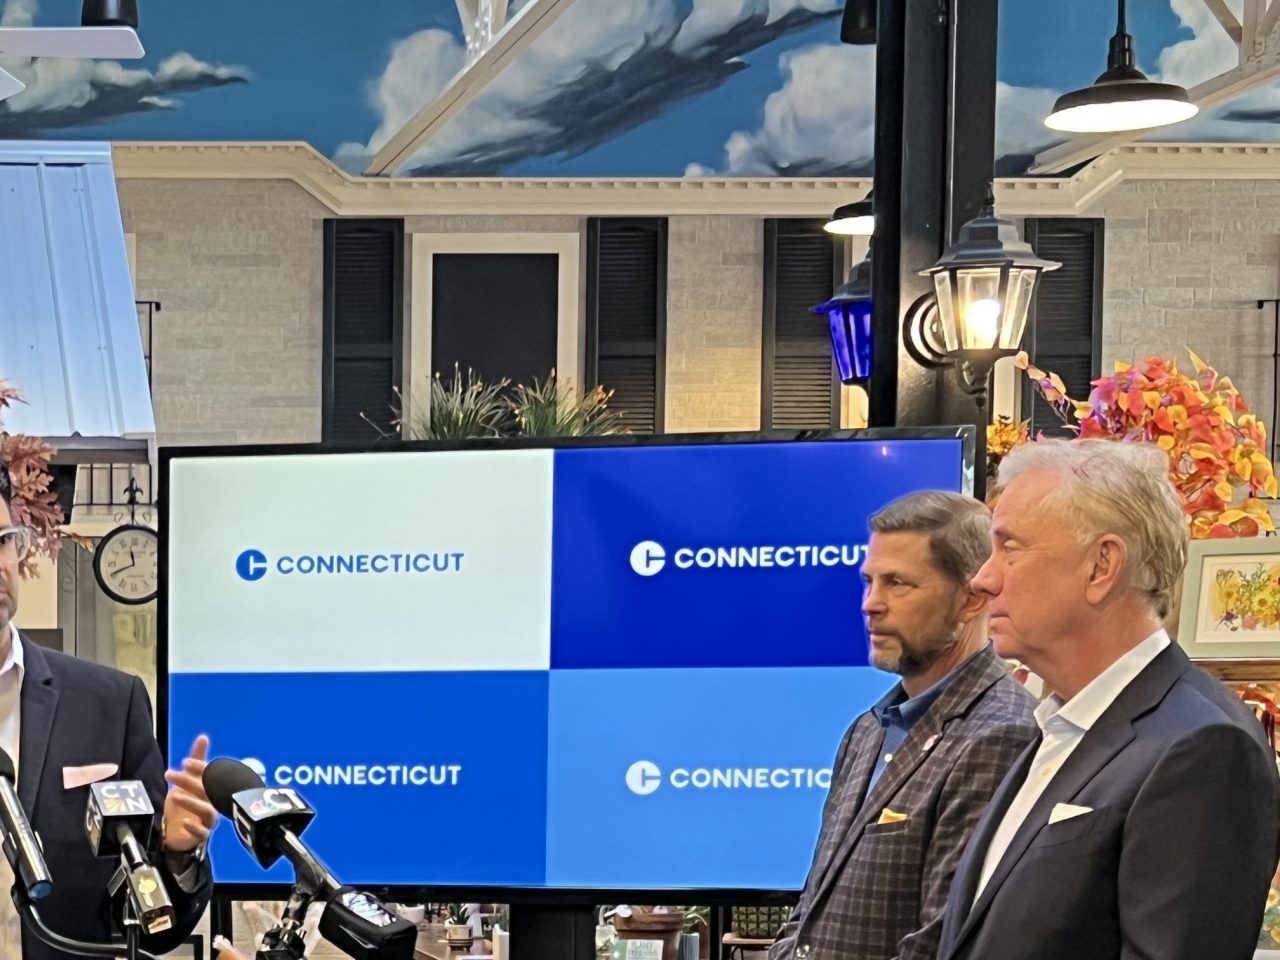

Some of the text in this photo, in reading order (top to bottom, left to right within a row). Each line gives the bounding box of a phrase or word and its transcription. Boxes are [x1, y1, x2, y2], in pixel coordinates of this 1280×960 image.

[276, 552, 465, 575] CONNECTICUT
[274, 764, 462, 787] CONNECTICUT
[669, 767, 833, 789] CONNECTIC
